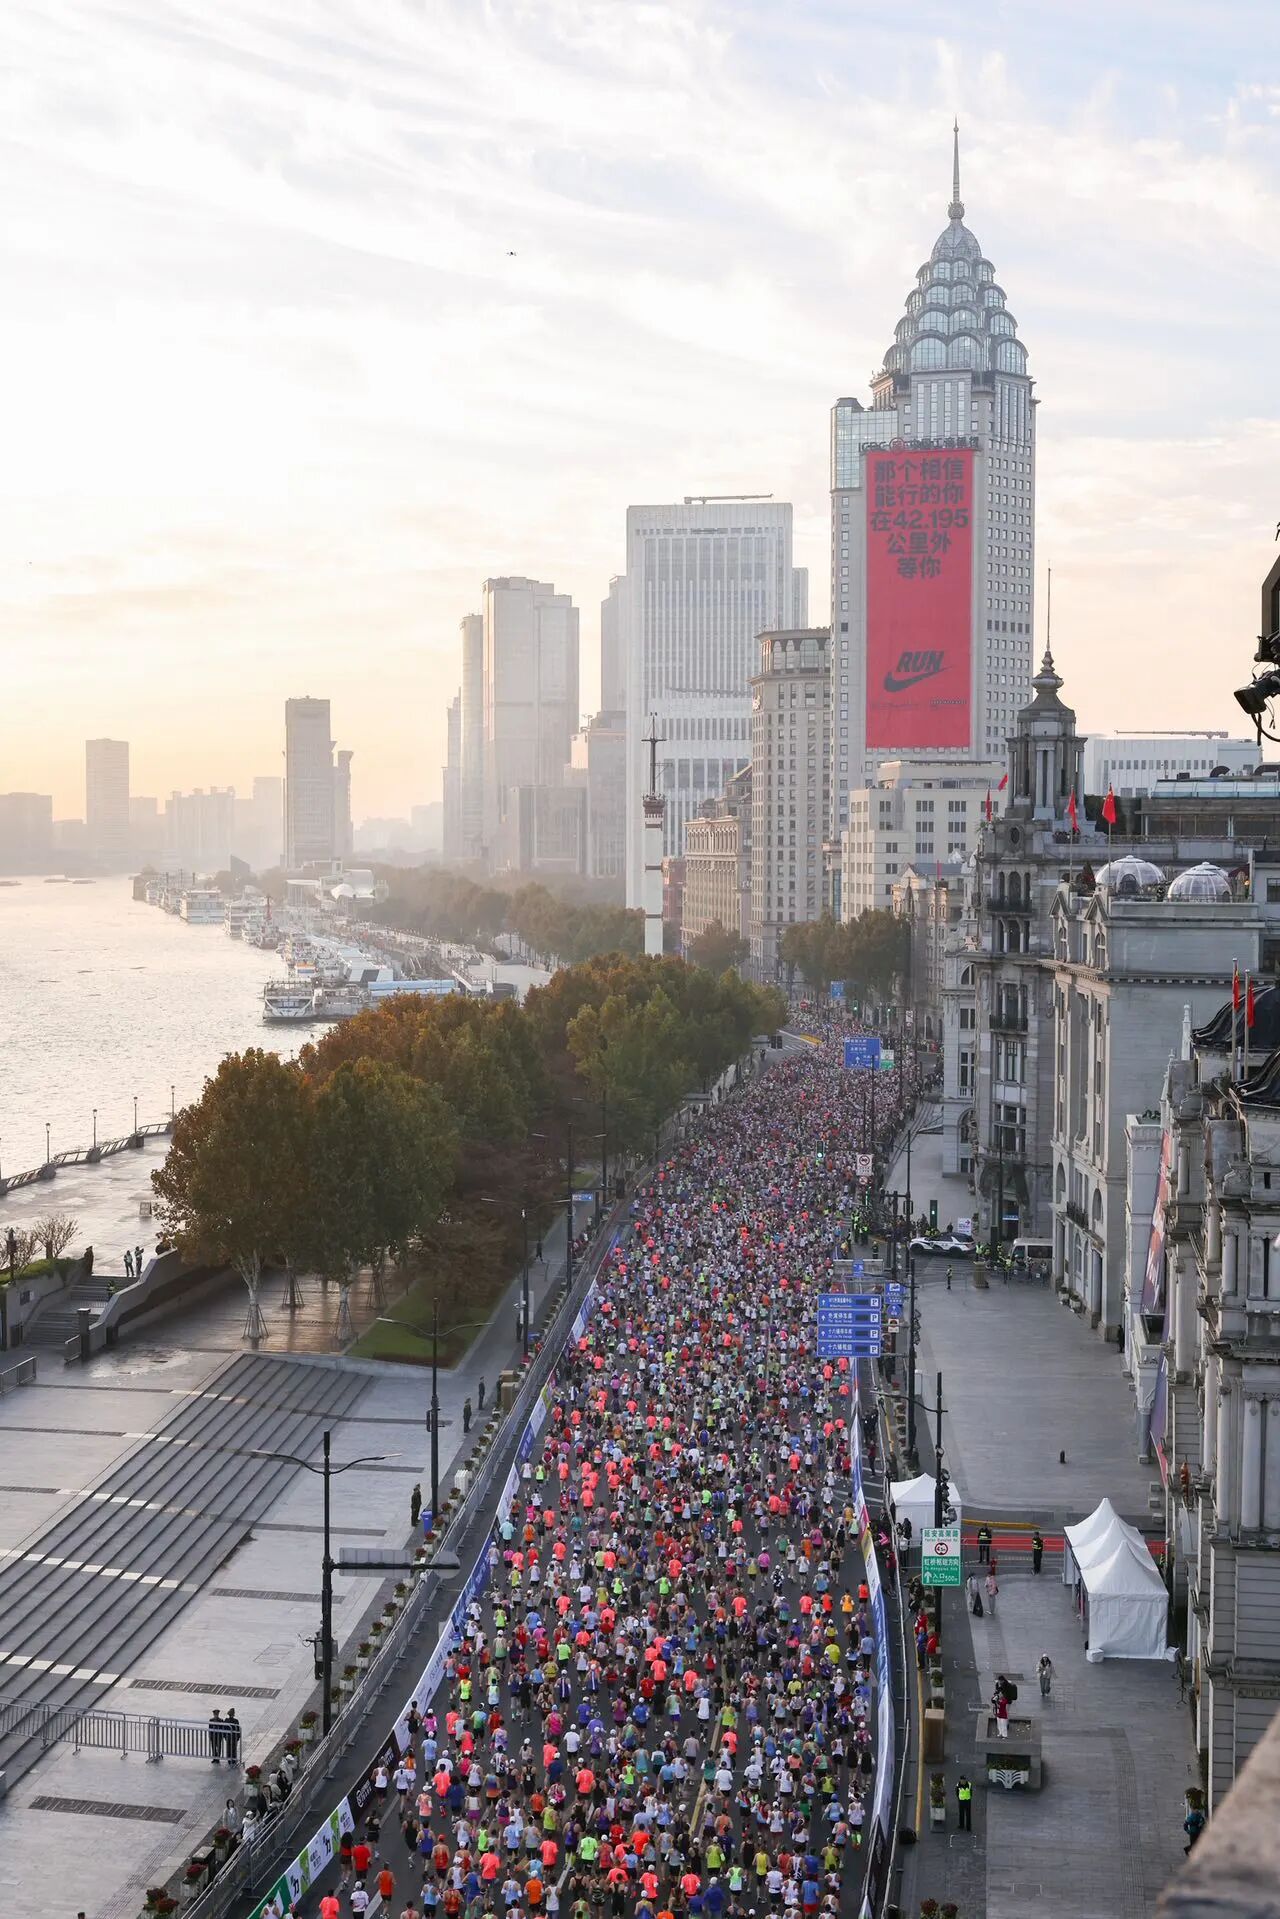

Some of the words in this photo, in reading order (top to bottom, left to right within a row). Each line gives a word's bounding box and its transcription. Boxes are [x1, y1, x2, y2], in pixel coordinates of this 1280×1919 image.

[875, 458, 965, 482] 那个相信
[875, 483, 965, 507] 能行的你
[871, 508, 969, 531] 在42.195
[887, 532, 951, 555] 公里外
[897, 557, 941, 579] 等你
[896, 651, 944, 672] RUN
